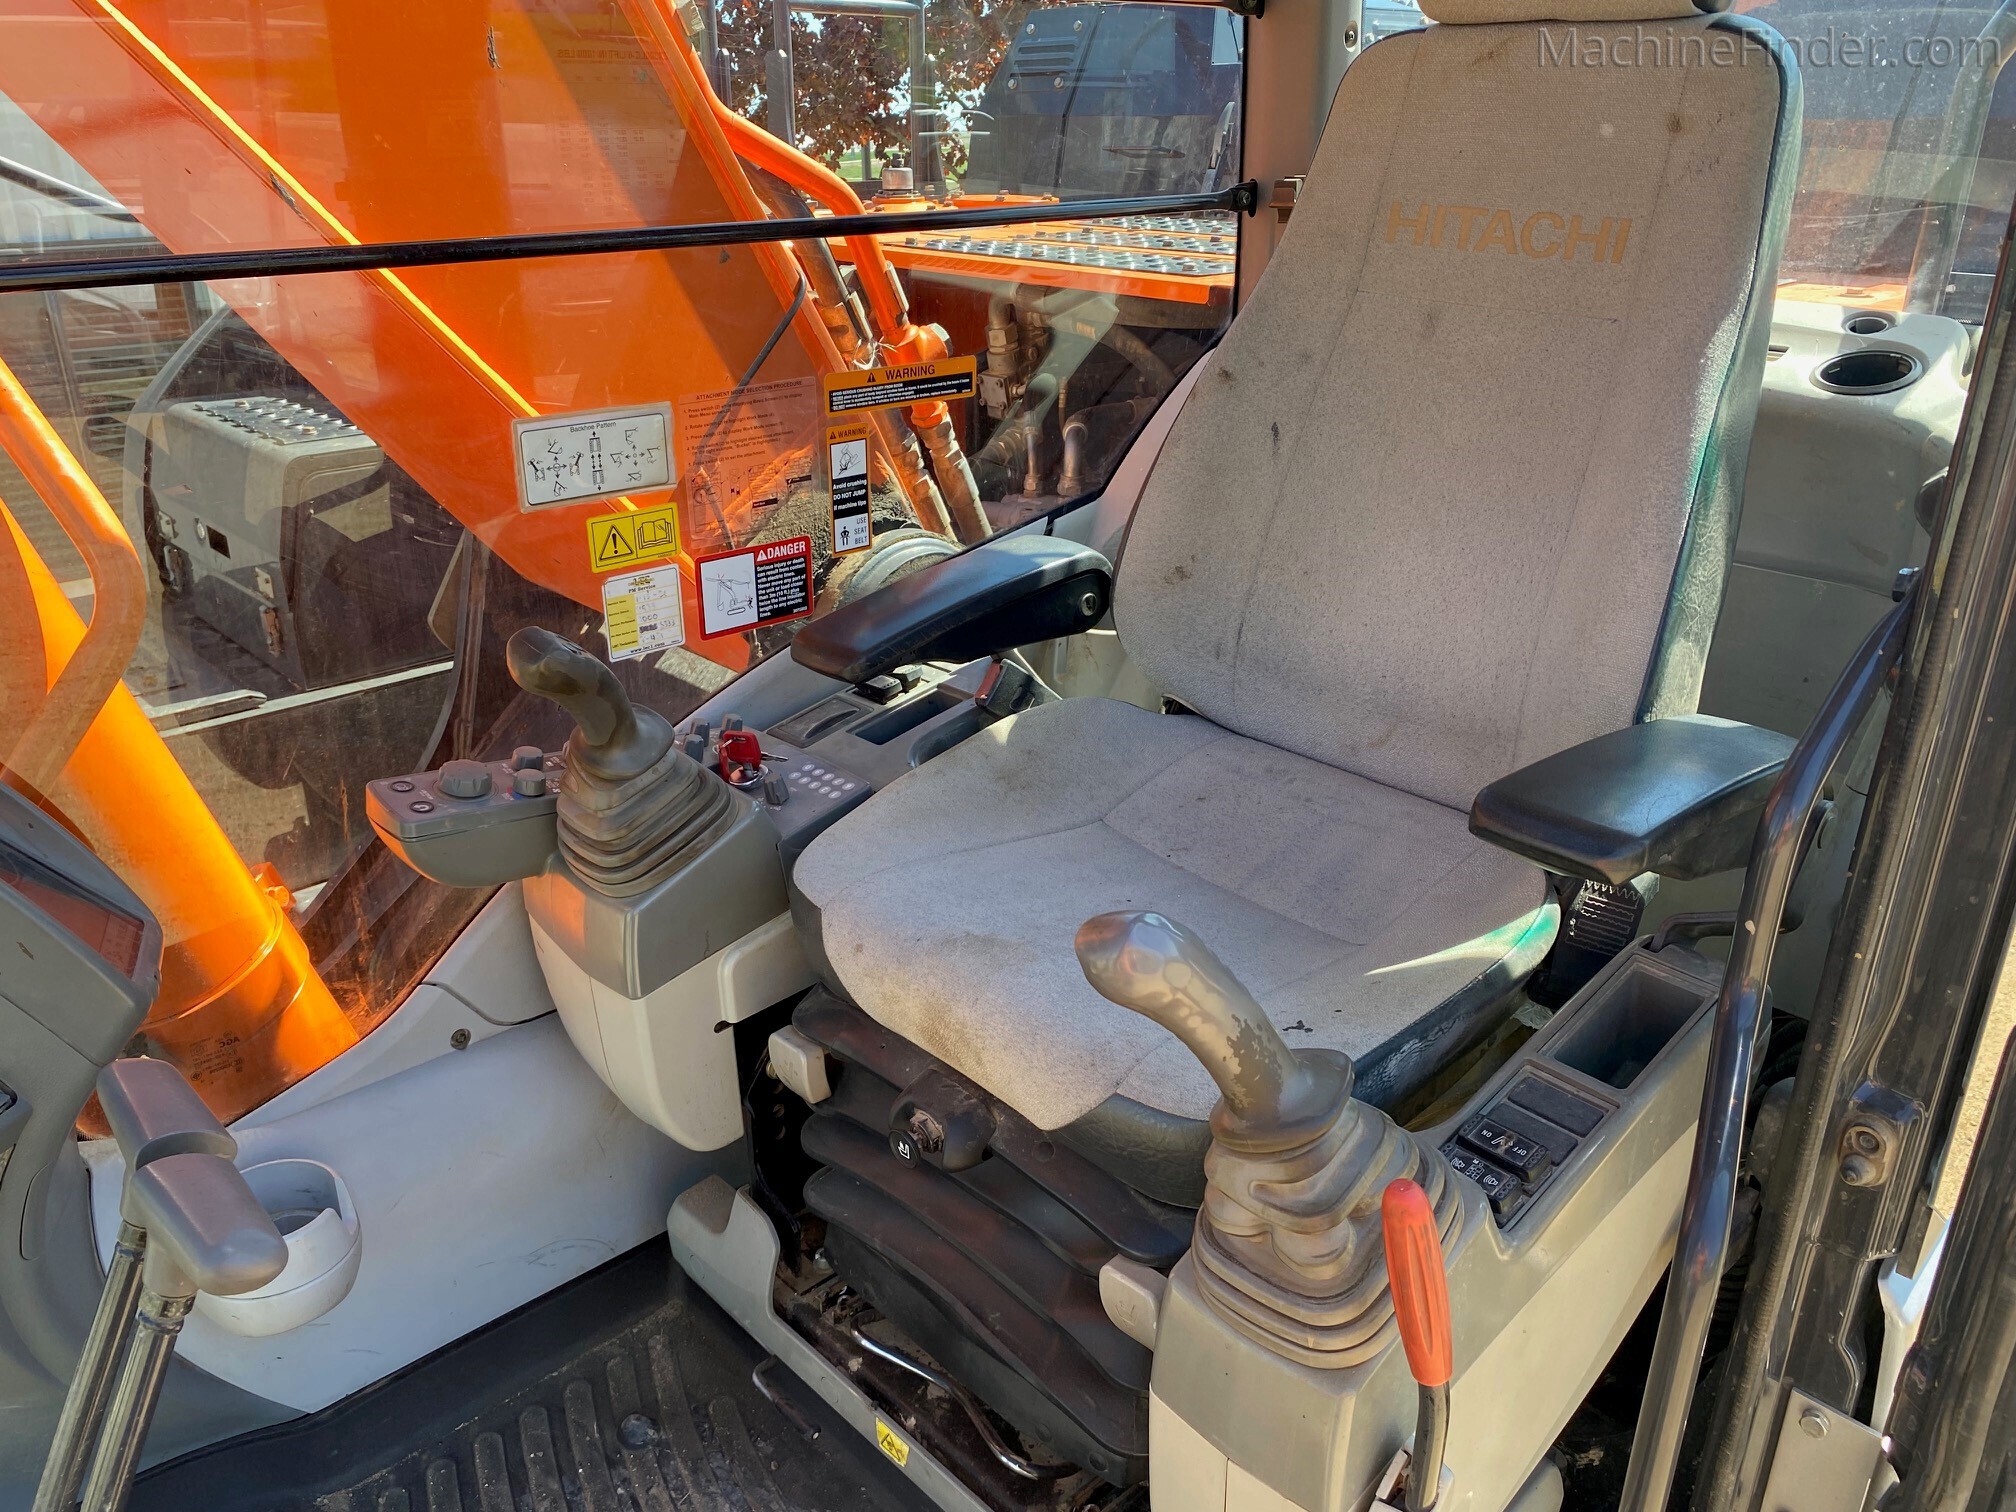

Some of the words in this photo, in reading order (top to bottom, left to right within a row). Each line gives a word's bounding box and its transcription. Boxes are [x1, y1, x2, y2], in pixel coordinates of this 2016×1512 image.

[1384, 201, 1633, 264] HITACHI
[886, 365, 935, 380] WARNING
[696, 391, 730, 400] ATTACHMENT
[773, 381, 802, 389] PROCEDURE
[570, 423, 595, 433] Backhoe
[596, 421, 617, 430] Pattern
[838, 427, 866, 438] WARNING
[847, 479, 867, 488] crushing
[854, 527, 867, 535] SEAT
[768, 542, 806, 559] DANGER
[1481, 1129, 1493, 1138] ON
[1512, 1146, 1527, 1156] OFF
